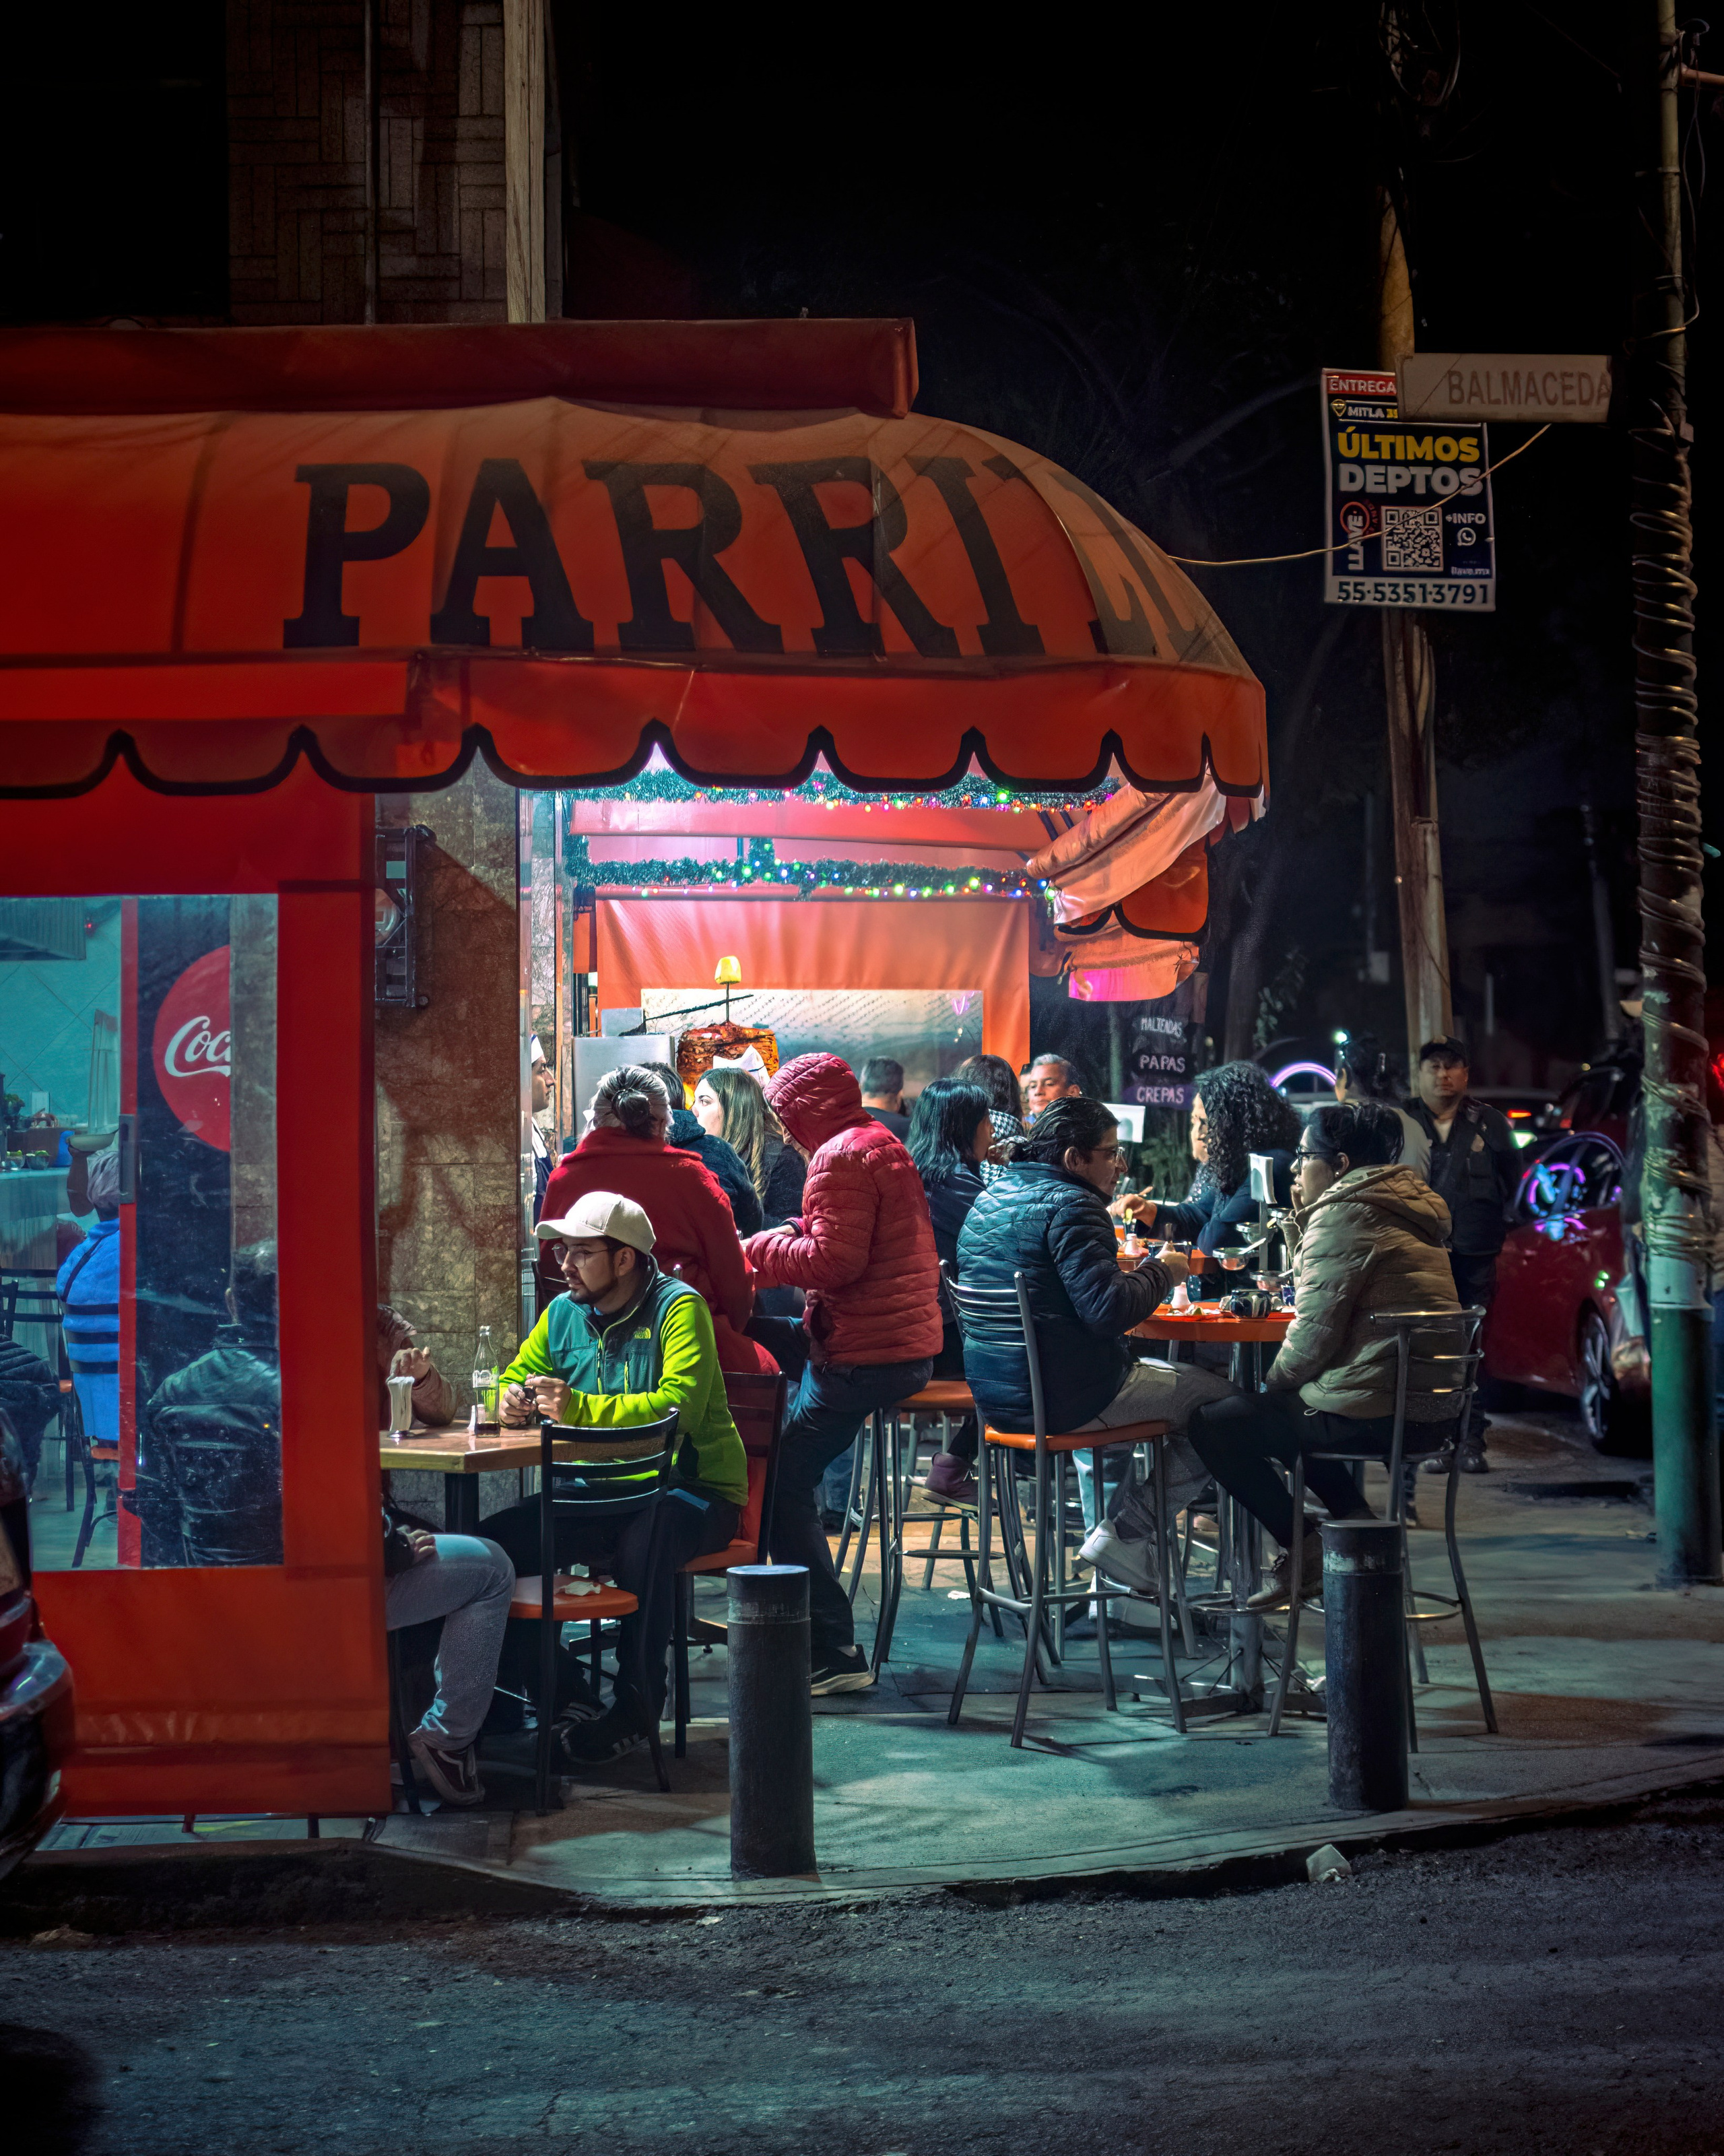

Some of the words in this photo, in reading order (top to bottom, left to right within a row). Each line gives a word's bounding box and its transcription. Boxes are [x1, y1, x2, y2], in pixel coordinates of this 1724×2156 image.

[1329, 379, 1397, 394] ENTREGA
[1448, 371, 1610, 405] BALMACEDA
[1348, 405, 1385, 418] MITLA
[1337, 426, 1480, 462] ÚLTIMOS
[1339, 463, 1484, 496] DEPTOS
[1139, 1054, 1186, 1073] PAPAS
[1137, 1086, 1185, 1104] CREPAS
